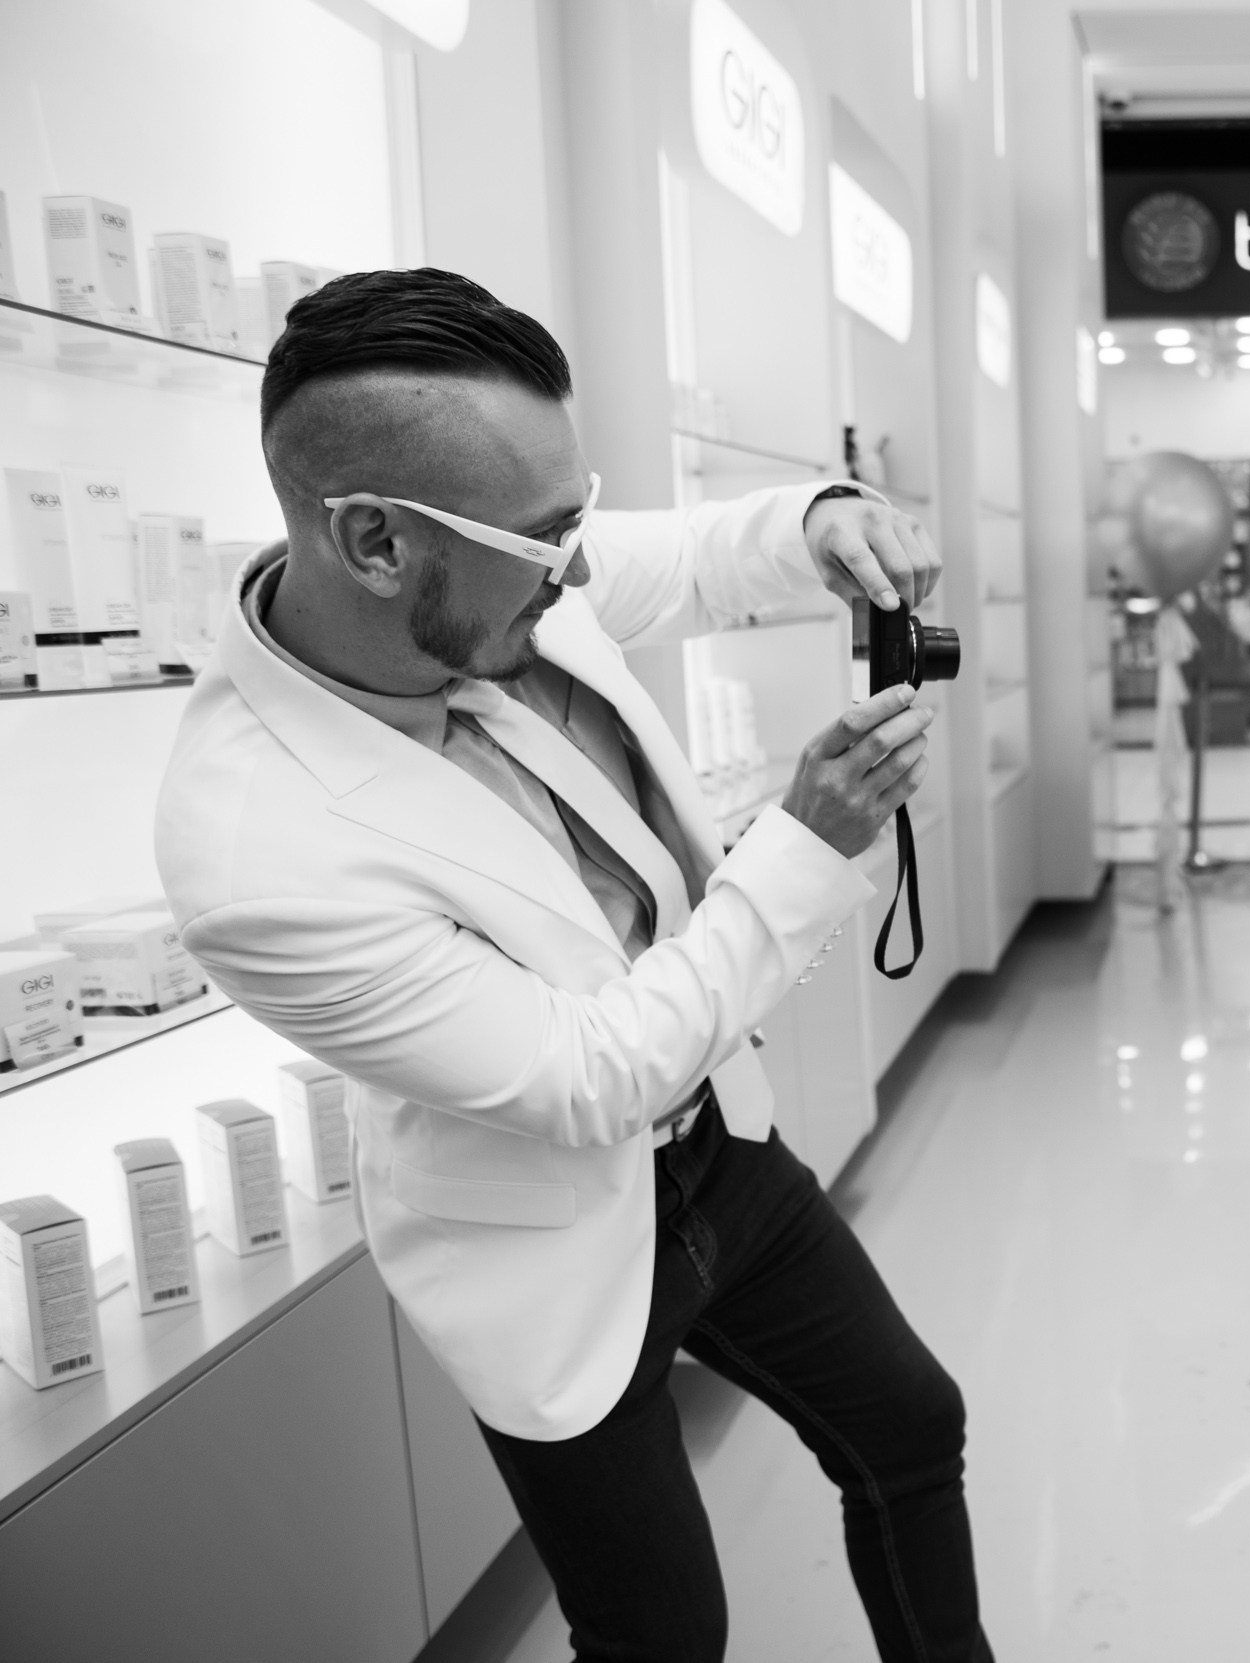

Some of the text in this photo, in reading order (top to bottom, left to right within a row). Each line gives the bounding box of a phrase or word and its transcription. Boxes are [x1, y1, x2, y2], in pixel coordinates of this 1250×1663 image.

[720, 48, 785, 171] GIGI
[87, 484, 120, 500] GIGI
[21, 974, 54, 995] GIGI
